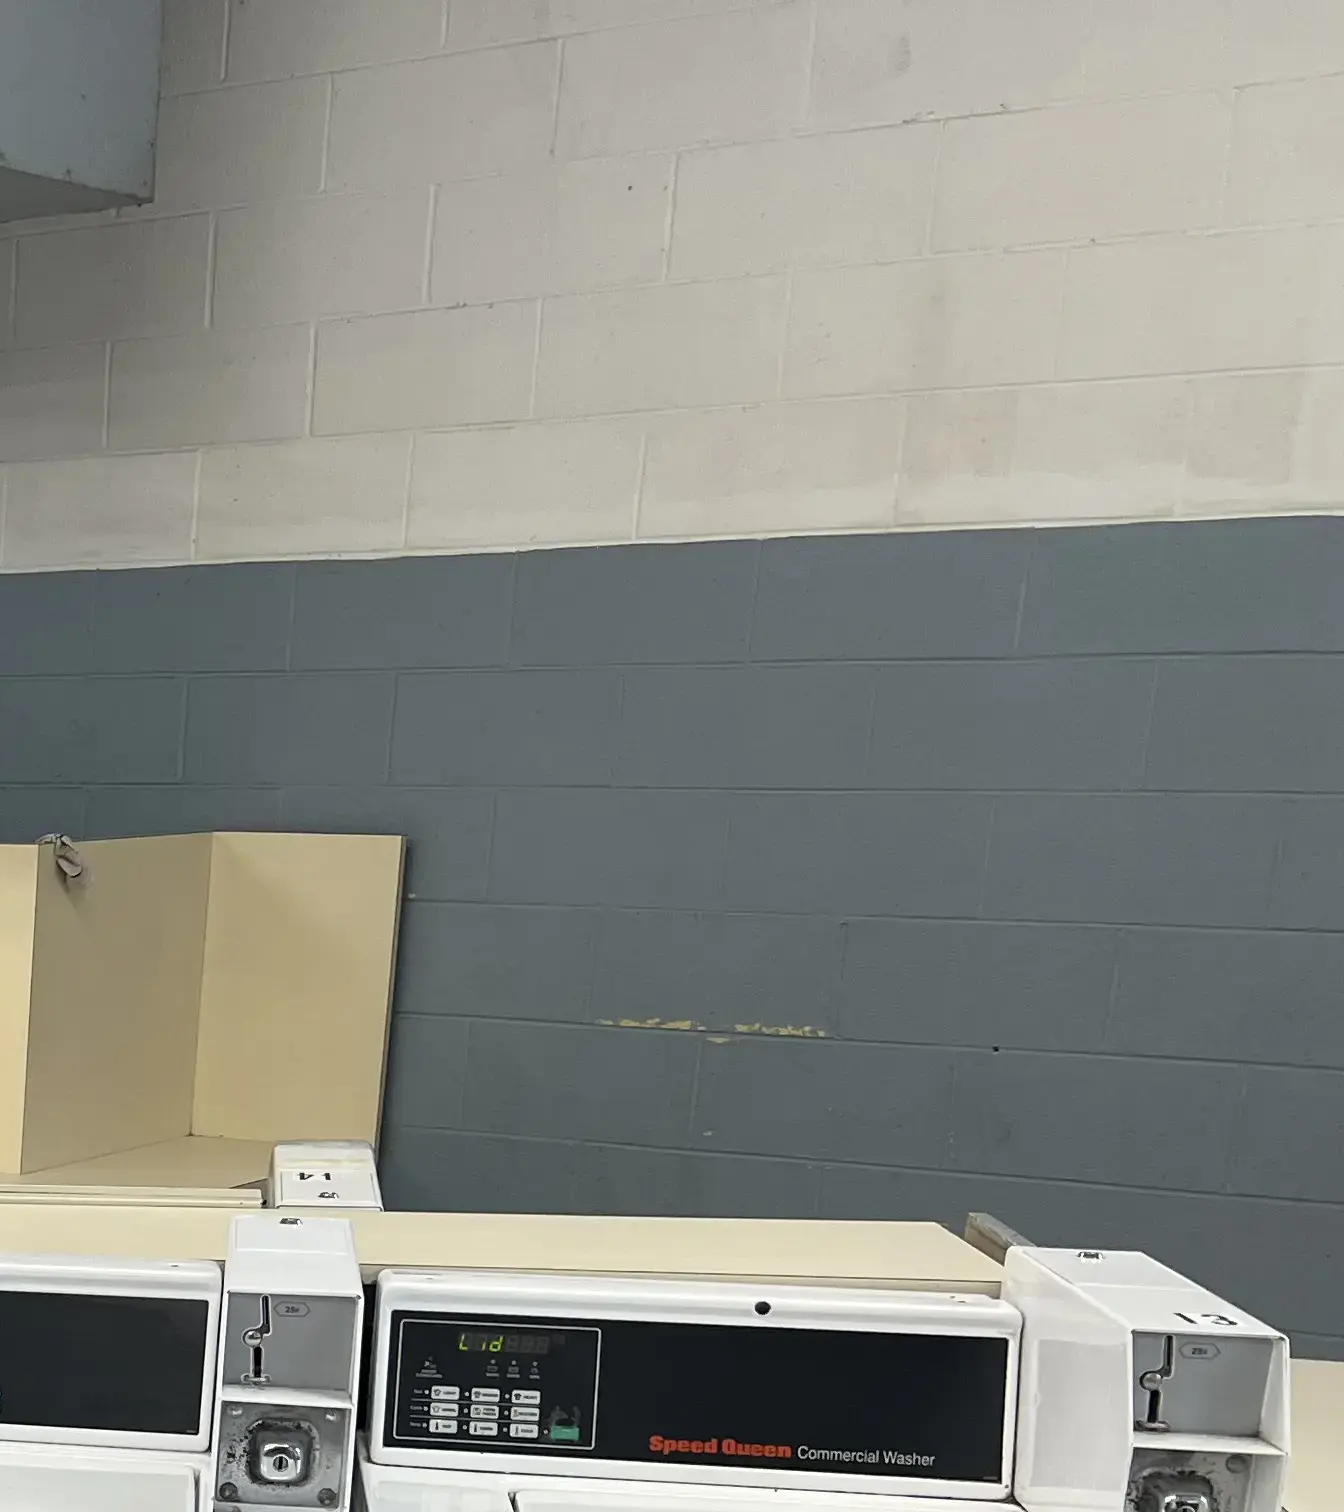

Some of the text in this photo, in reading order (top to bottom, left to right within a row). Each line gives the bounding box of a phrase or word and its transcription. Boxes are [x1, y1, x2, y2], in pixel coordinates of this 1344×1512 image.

[1173, 1312, 1238, 1326] 13
[649, 1435, 936, 1467] Speed Queen Commercial Washer
